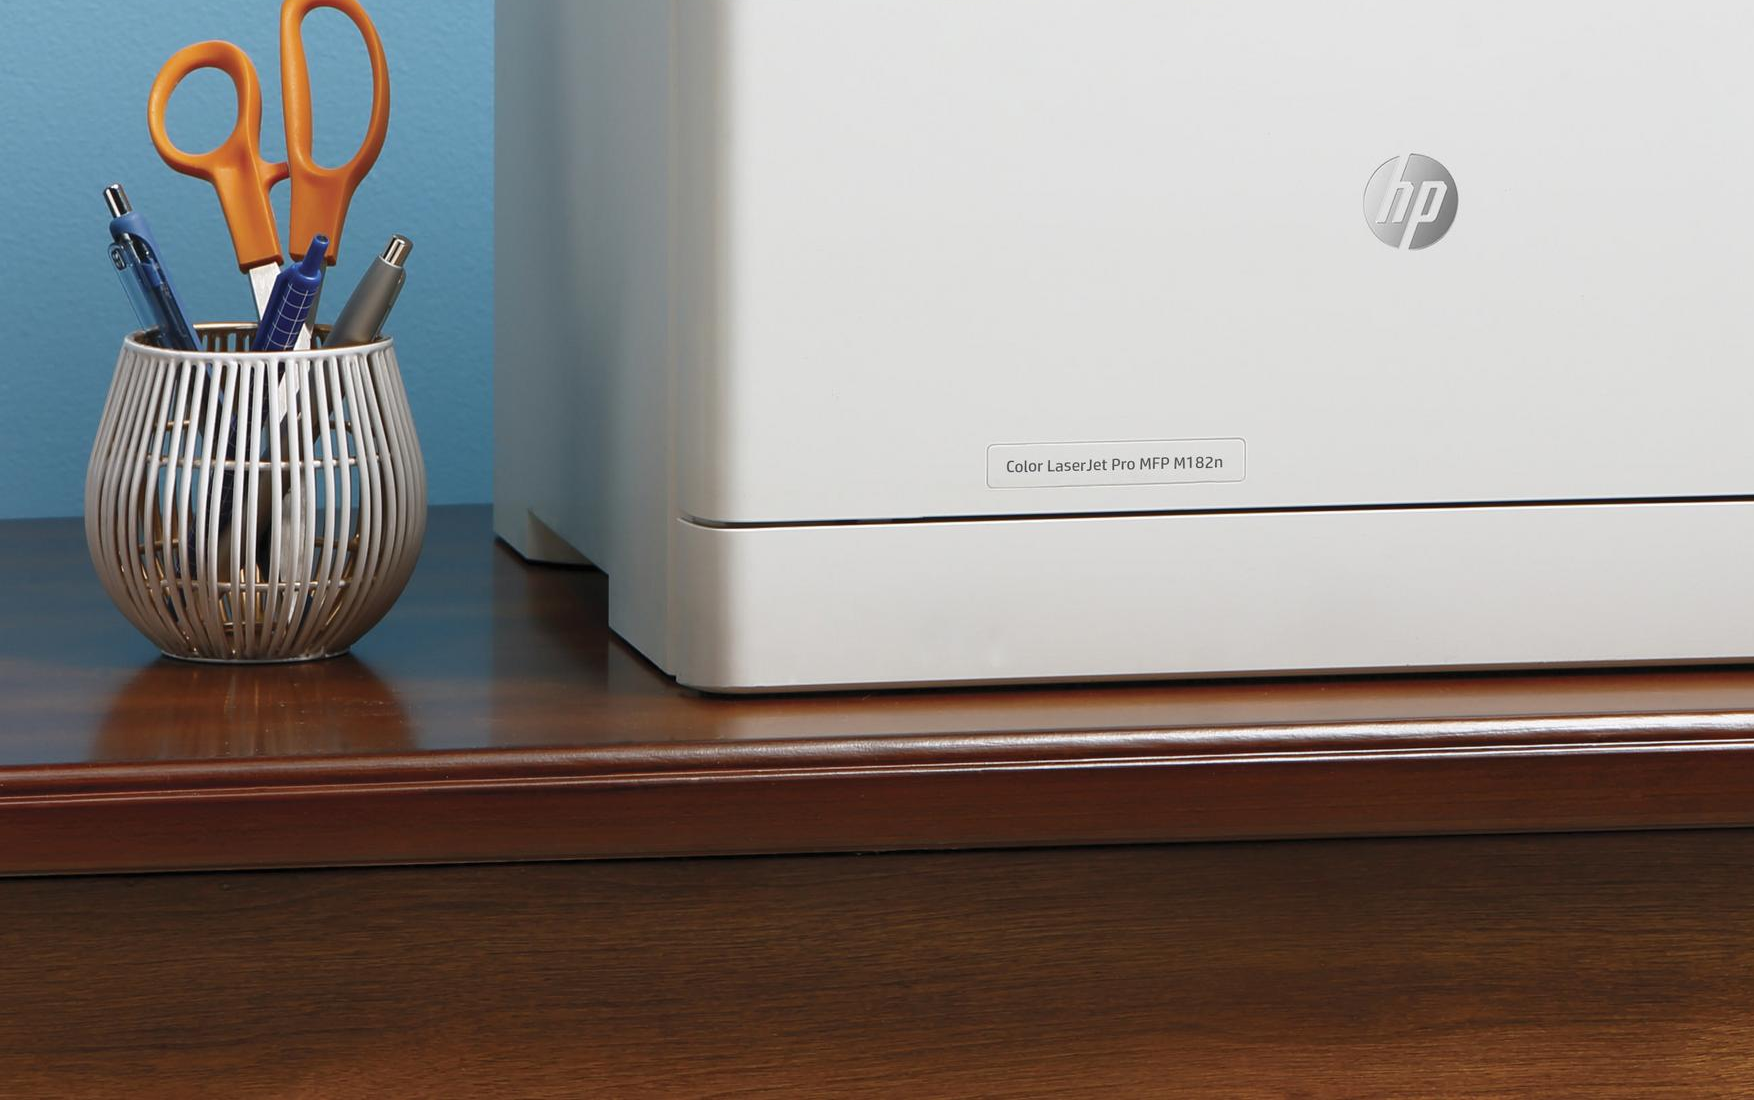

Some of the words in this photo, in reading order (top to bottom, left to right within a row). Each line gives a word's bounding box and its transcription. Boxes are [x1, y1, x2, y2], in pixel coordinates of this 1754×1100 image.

[1372, 153, 1450, 249] hp
[1006, 459, 1043, 473] Color
[1047, 458, 1108, 473] LaserJet
[1111, 458, 1136, 471] Pro
[1140, 456, 1170, 470] MFP
[1174, 456, 1223, 470] M182n
